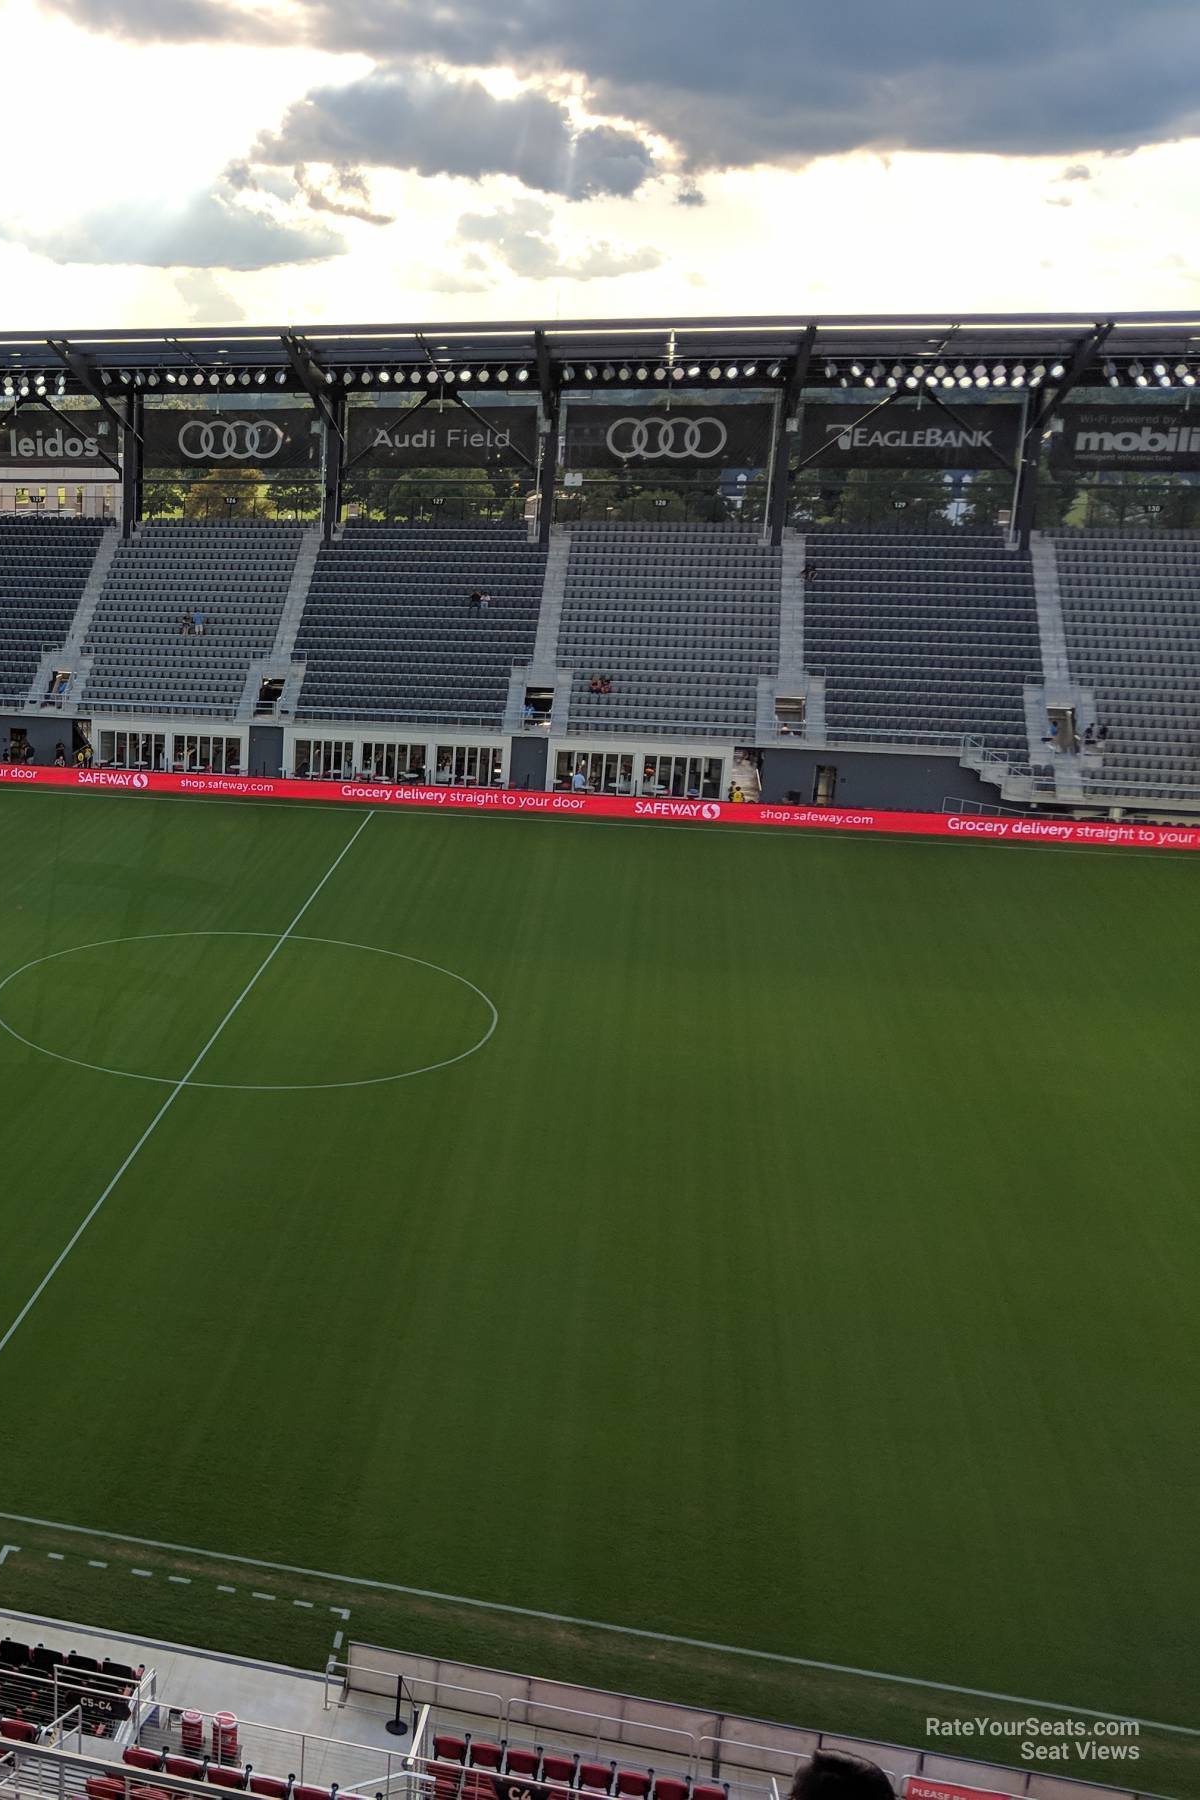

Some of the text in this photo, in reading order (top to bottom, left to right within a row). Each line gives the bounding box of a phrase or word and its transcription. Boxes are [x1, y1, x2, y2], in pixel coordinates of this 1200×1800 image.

[10, 428, 99, 457] leidos
[372, 428, 510, 448] Audi Field
[11, 767, 38, 779] door
[78, 771, 132, 786] SAFEWAY
[180, 778, 274, 792] shop.safeway.com
[341, 785, 585, 809] Grocery delivery straight to your door
[634, 801, 701, 817] SAFEWAY
[760, 808, 874, 825] shop.safeway.com
[948, 816, 1195, 844] Grocery delivery straight to your
[80, 1696, 113, 1712] C5-C4
[508, 1786, 531, 1800] C4
[911, 1787, 951, 1800] PLEASE
